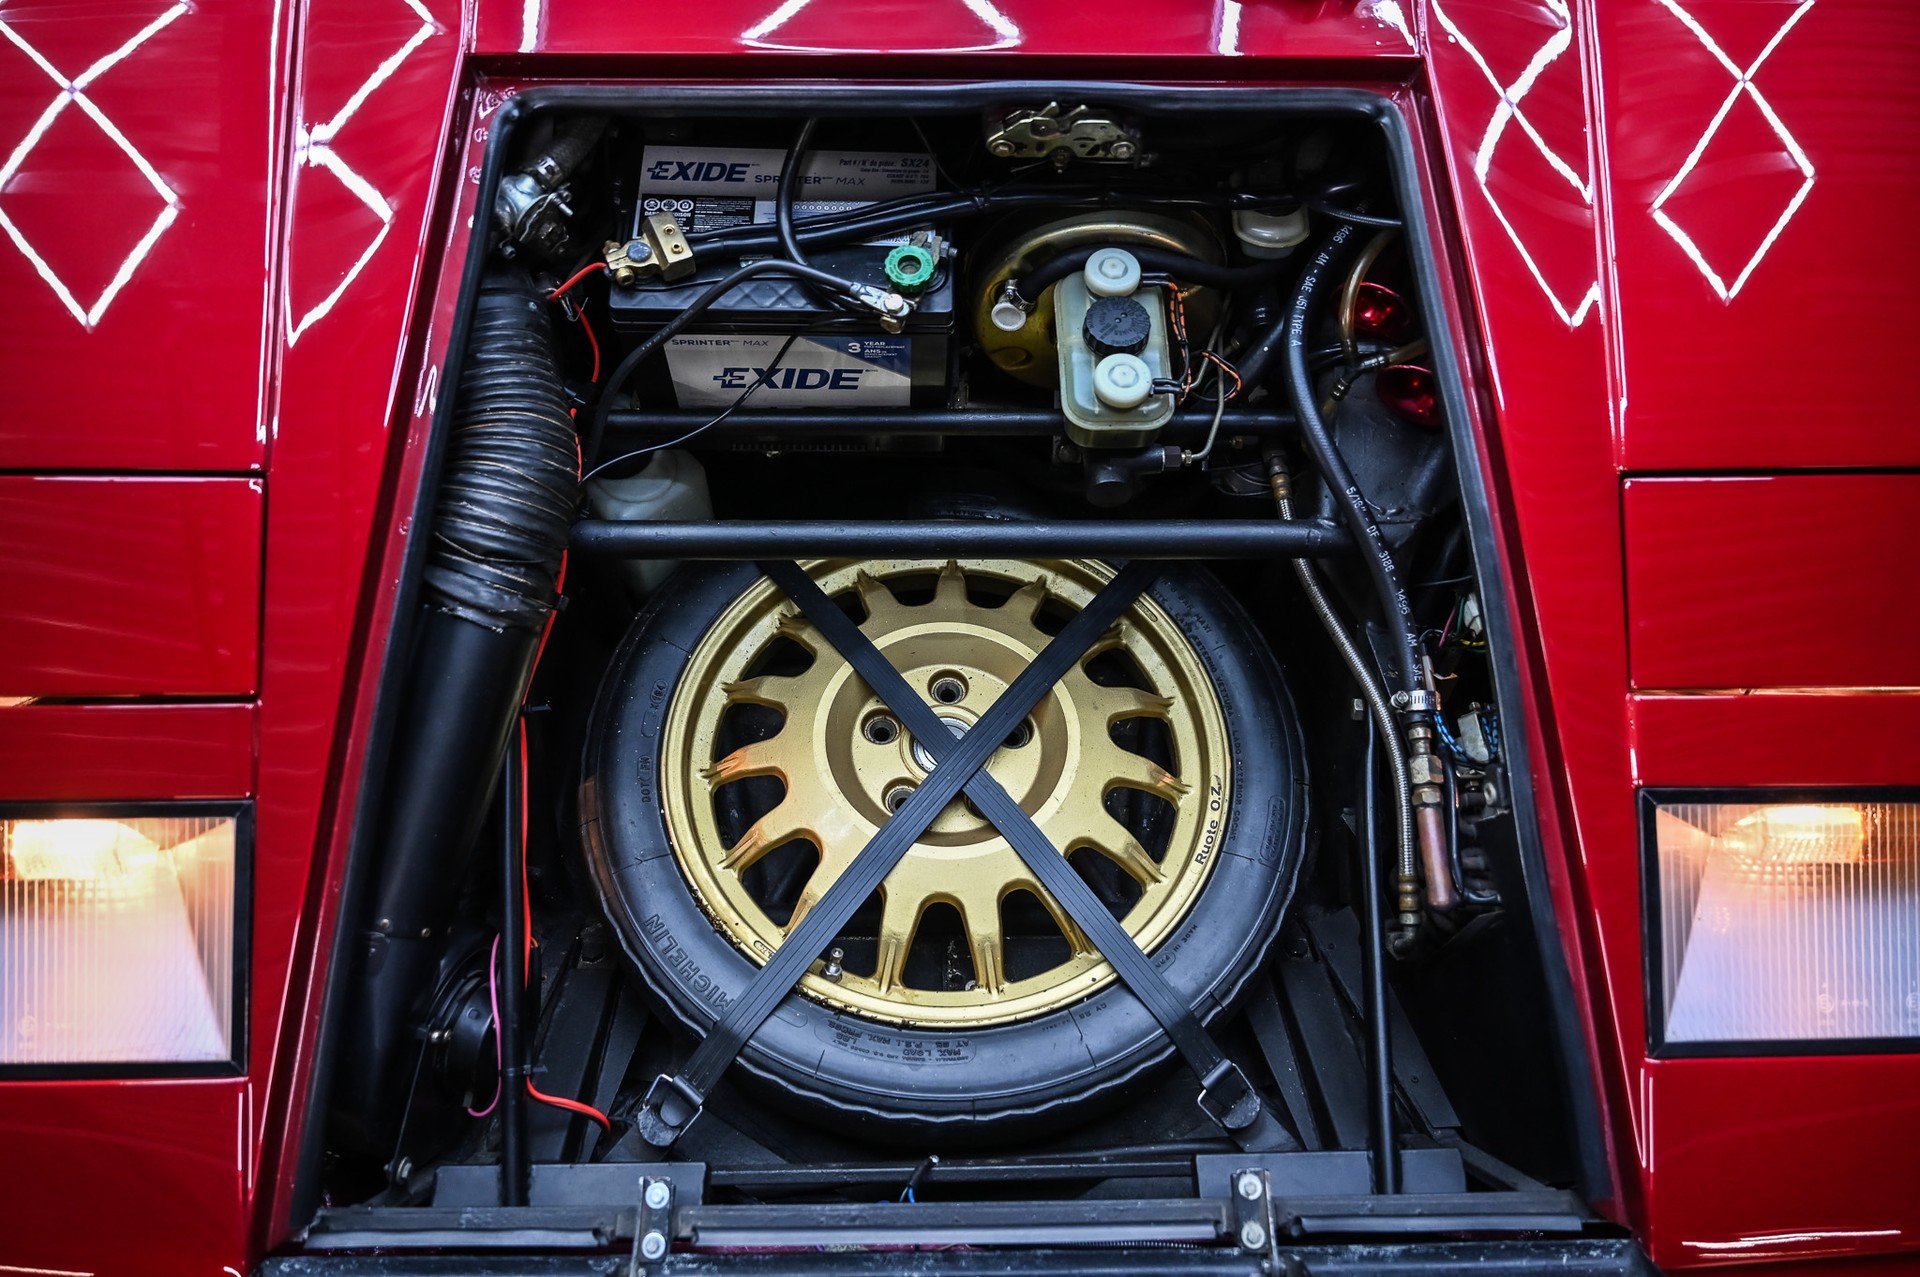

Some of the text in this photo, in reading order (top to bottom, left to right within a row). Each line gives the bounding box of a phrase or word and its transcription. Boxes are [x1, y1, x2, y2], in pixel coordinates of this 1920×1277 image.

[647, 160, 752, 183] EXIDE
[901, 158, 929, 167] SX24
[755, 174, 865, 186] SPRTER MAX
[1333, 225, 1353, 244] 1496
[1301, 275, 1316, 293] SAE
[1291, 314, 1304, 335] TYPE
[672, 339, 731, 347] SPRINTER
[848, 342, 861, 353] 3
[713, 367, 864, 390] EXIDE
[1366, 525, 1380, 537] DF
[1395, 588, 1411, 615] 1496
[1405, 633, 1418, 648] AM
[1412, 664, 1424, 682] SAE
[1232, 729, 1242, 754] LADO
[641, 782, 652, 804] DOT
[1195, 820, 1219, 865] Ruote
[1180, 924, 1198, 943] MADE
[1171, 944, 1181, 953] IN
[645, 913, 735, 1013] MICHELIN
[901, 1048, 931, 1056] LOAD
[955, 1039, 969, 1048] AT
